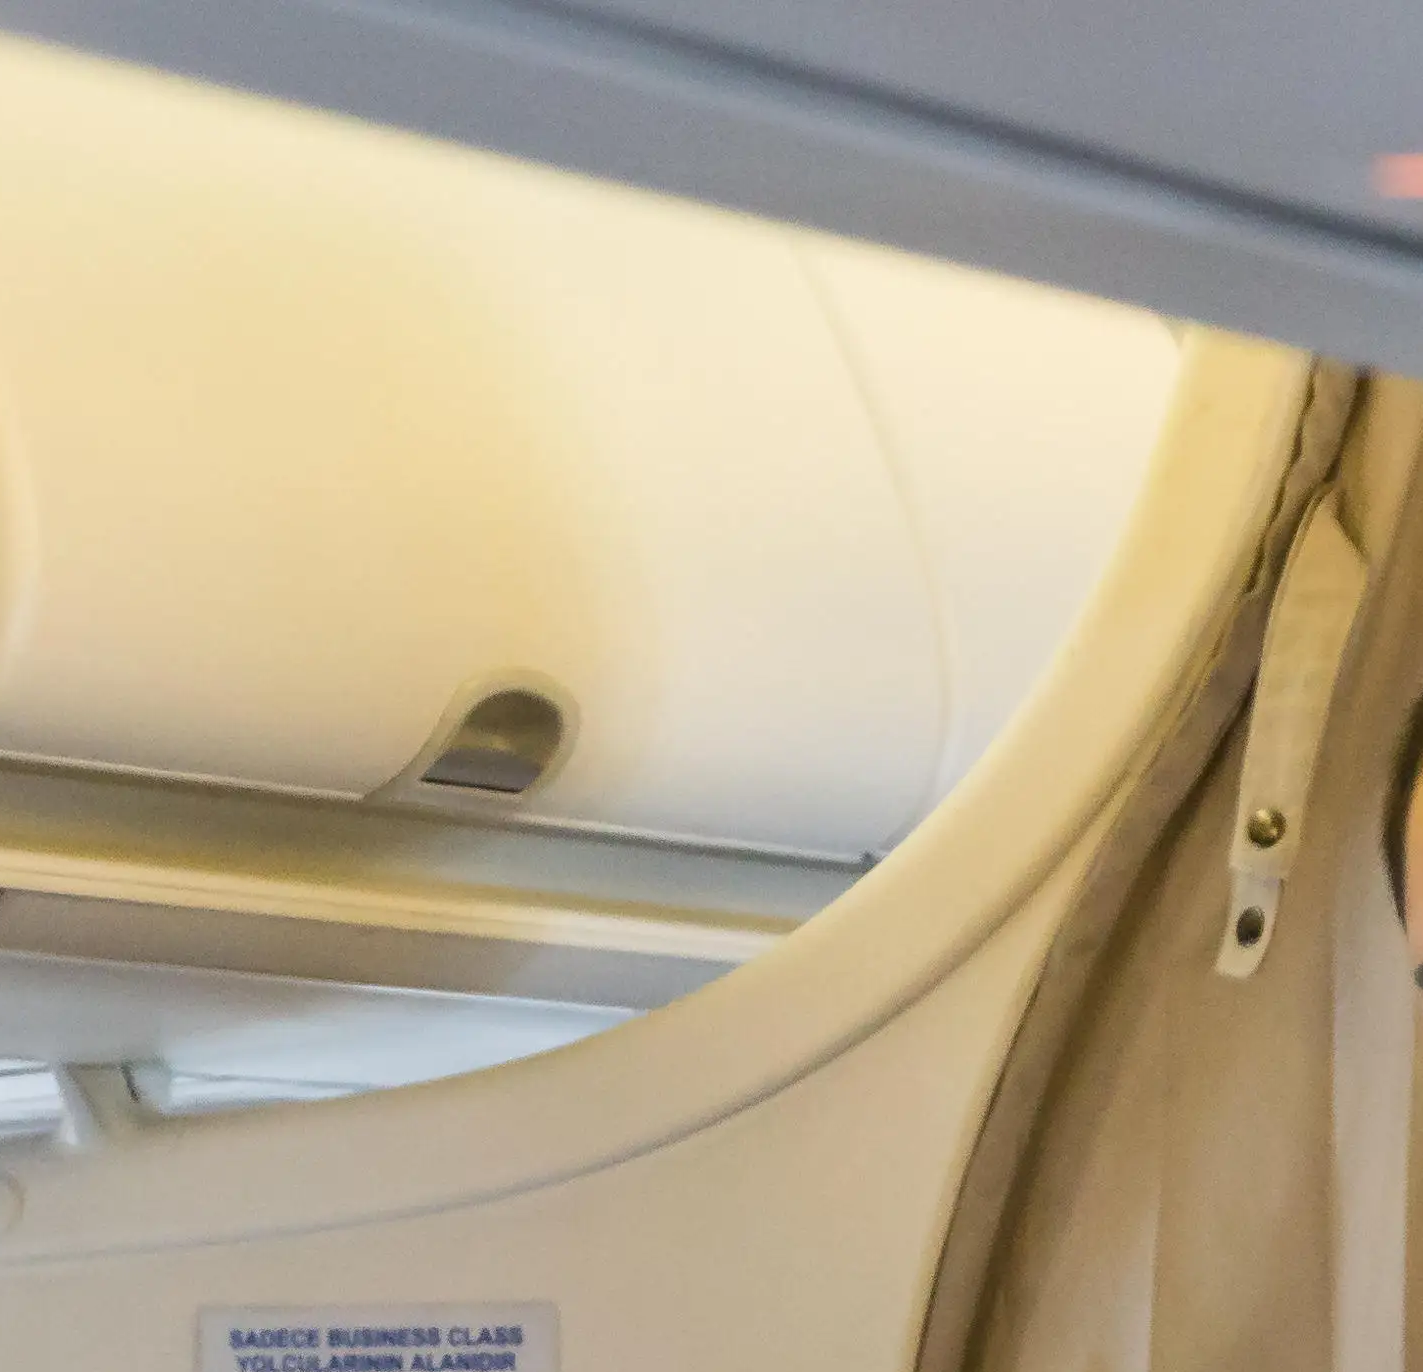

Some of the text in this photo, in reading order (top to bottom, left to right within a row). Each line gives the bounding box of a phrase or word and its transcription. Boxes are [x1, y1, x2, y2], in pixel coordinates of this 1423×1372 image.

[229, 1326, 523, 1348] SADECE BUSINESS CLASS
[409, 1352, 516, 1372] ALANIDIR
